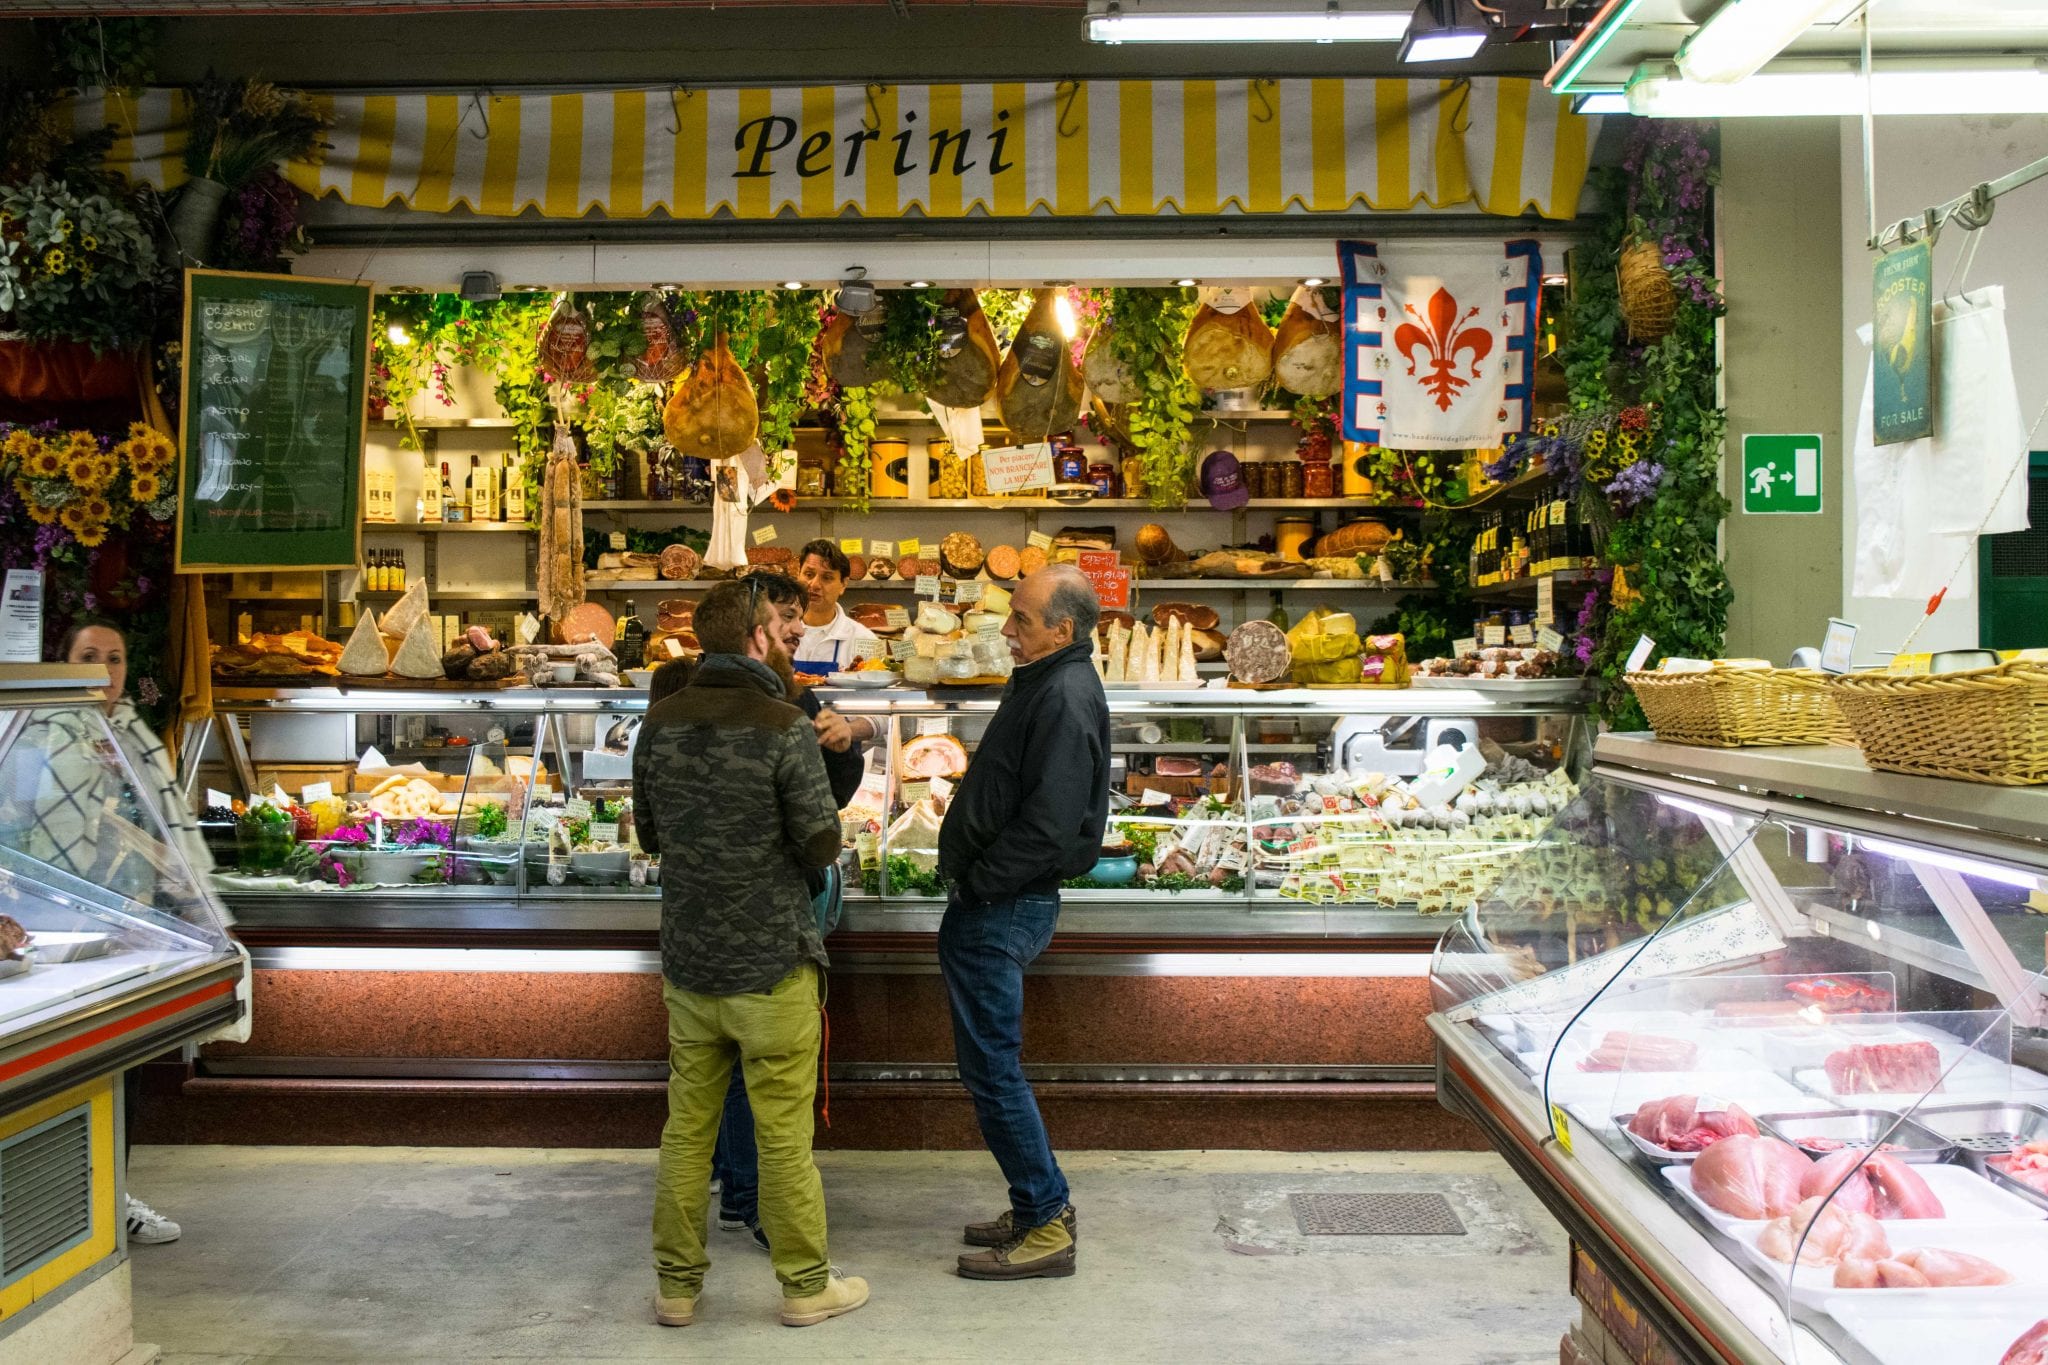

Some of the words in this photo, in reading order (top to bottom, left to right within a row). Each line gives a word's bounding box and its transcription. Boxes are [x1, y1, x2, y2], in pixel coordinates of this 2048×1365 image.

[731, 110, 1013, 177] Perini
[1876, 278, 1926, 311] ROOSTER
[205, 306, 263, 318] ORGASMIC
[206, 321, 256, 331] COSMIC
[207, 355, 251, 363] SPECIAL
[208, 373, 249, 385] VEGAN
[207, 407, 250, 416] ASTRO
[1881, 414, 1898, 429] FOR
[1900, 407, 1924, 424] SALE
[208, 432, 251, 440] TORPEDO
[1000, 456, 1010, 464] Per
[1012, 454, 1035, 463] piacere
[990, 466, 1005, 475] NON
[1005, 477, 1013, 485] LA
